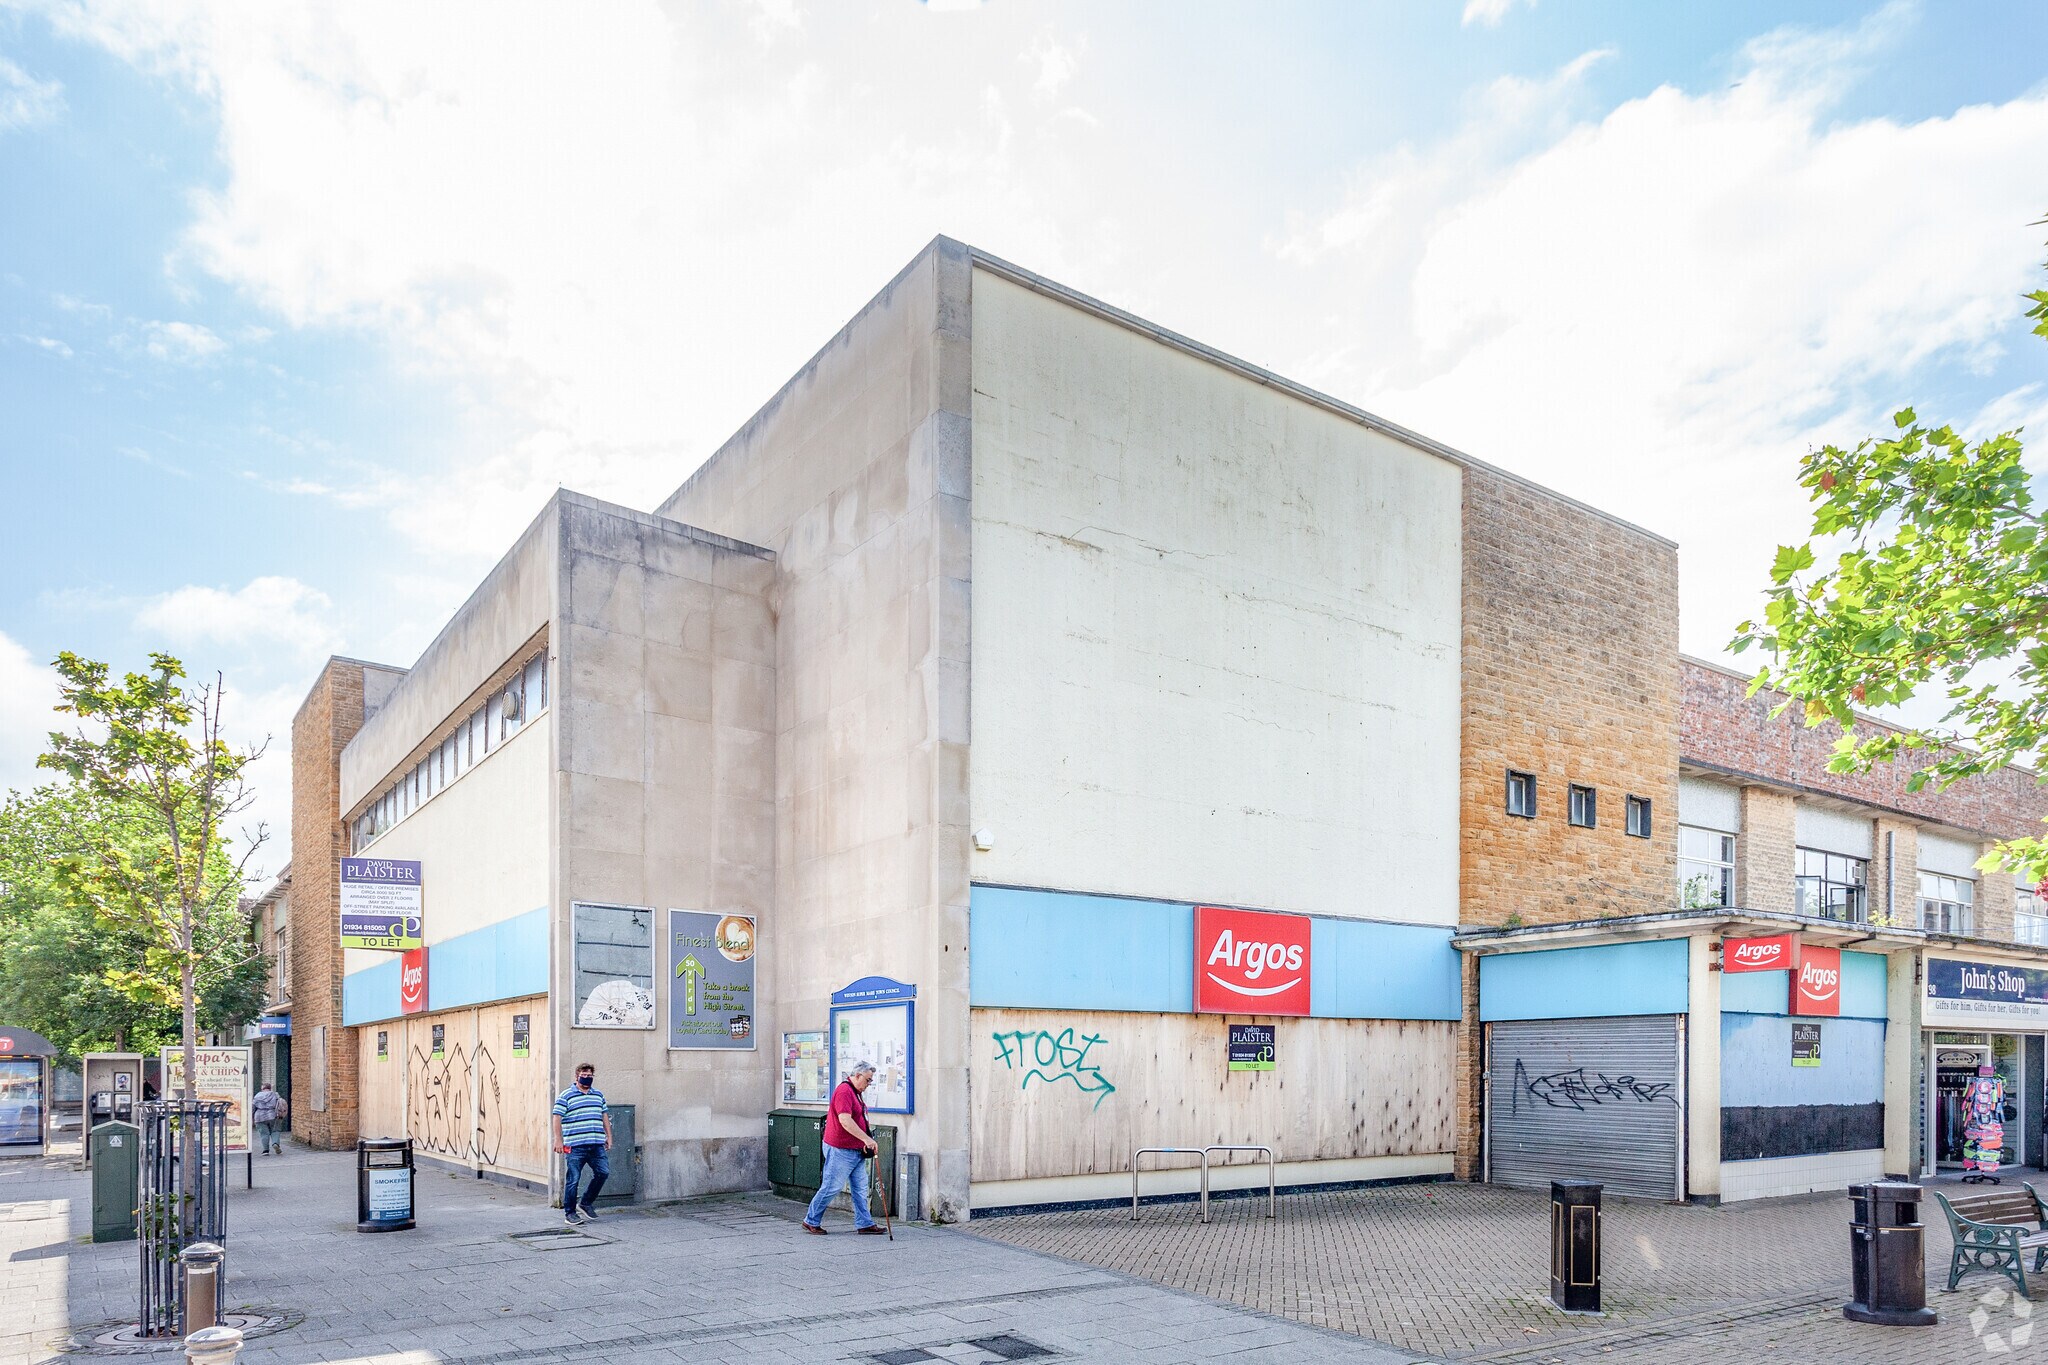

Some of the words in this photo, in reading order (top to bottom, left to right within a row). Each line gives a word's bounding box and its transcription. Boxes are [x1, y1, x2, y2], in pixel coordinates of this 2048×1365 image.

[367, 860, 393, 869] DAVID
[346, 865, 416, 879] PLAISTER
[361, 937, 378, 947] TO
[381, 938, 402, 947] LET
[675, 932, 711, 949] Finest
[716, 936, 750, 951] Blend
[1207, 929, 1304, 980] Argos
[1734, 943, 1781, 960] Argos
[402, 964, 422, 993] Argos
[1800, 962, 1838, 991] Argos
[1960, 967, 1996, 994] John's
[1997, 970, 2025, 998] Shop
[703, 982, 721, 991] Take
[729, 983, 750, 992] break
[703, 992, 721, 1001] from
[722, 993, 734, 1001] the
[703, 1002, 721, 1012] High
[1935, 1000, 1949, 1010] Gifts
[1950, 1001, 1959, 1010] for
[1973, 1002, 1987, 1012] Gifts
[1988, 1003, 1996, 1012] for
[2008, 1004, 2021, 1014] Gifts
[2021, 1005, 2030, 1014] for
[1232, 1032, 1272, 1042] PLAISTER
[1794, 1030, 1819, 1040] PLAISTER
[195, 1051, 231, 1066] apa's
[210, 1066, 240, 1076] CHIPS
